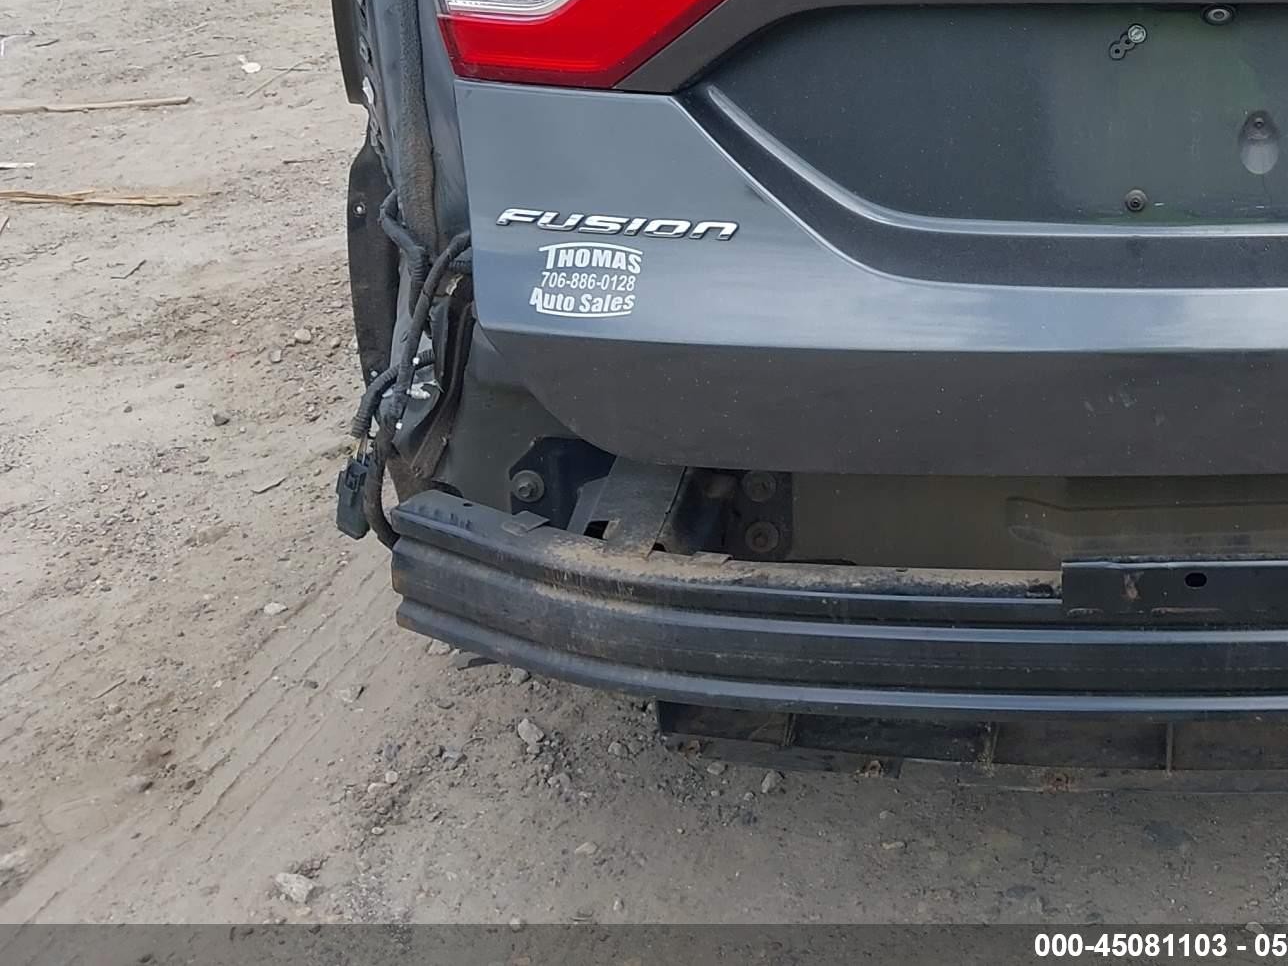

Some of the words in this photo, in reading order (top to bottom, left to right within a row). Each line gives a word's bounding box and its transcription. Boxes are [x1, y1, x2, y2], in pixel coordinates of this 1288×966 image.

[496, 208, 740, 241] FUSION
[539, 242, 643, 274] THOMAS
[540, 271, 637, 292] 706-886-0128
[529, 287, 574, 314] Auto
[579, 293, 636, 313] Sales
